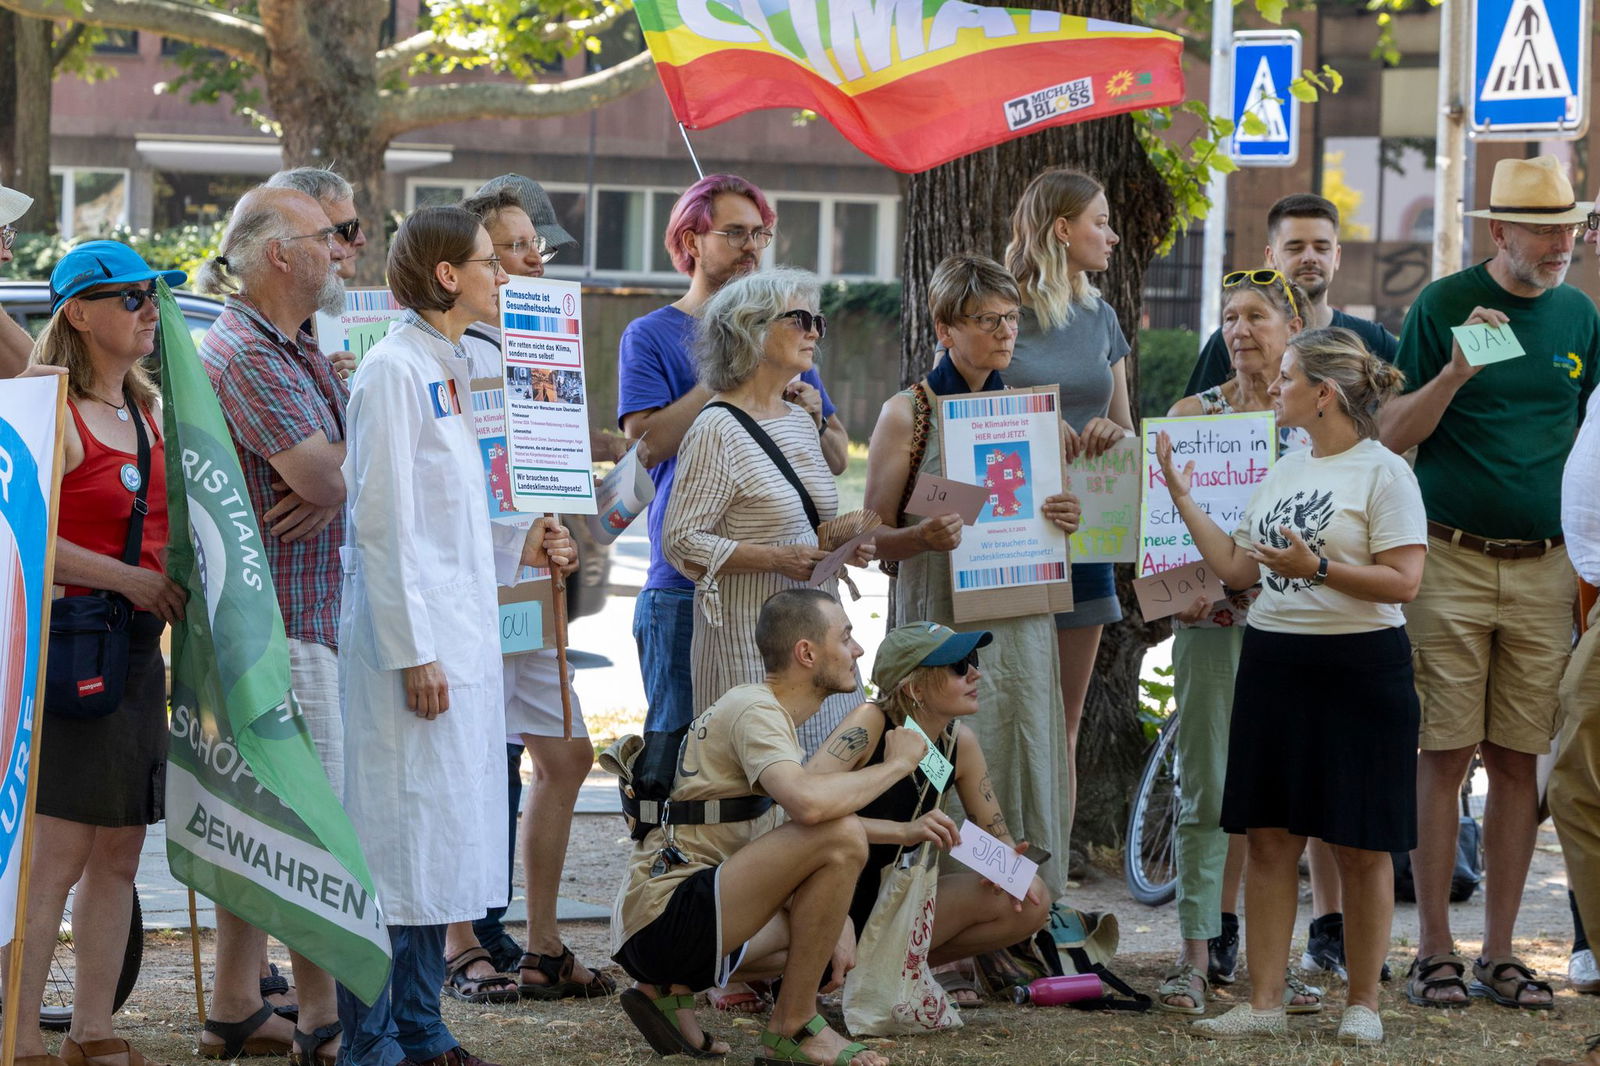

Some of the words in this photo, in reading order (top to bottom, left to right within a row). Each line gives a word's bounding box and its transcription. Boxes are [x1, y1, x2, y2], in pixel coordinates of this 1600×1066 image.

[1031, 79, 1089, 105] MICHAEL
[505, 289, 541, 302] Klimaschutz
[541, 293, 550, 302] ist
[506, 300, 561, 315] Gesundheitsschutz
[341, 316, 351, 324] Die
[352, 315, 383, 324] Klimakrise
[1468, 327, 1511, 352] JA!
[508, 340, 516, 348] Wir
[516, 341, 532, 349] retten
[532, 342, 545, 350] nicht
[555, 345, 572, 354] Klima,
[508, 350, 528, 358] sondern
[538, 352, 555, 360] selbst!
[971, 421, 984, 430] Die
[984, 419, 1020, 429] Klimakrise
[1020, 418, 1029, 427] ist
[975, 432, 992, 441] HIER
[992, 431, 1006, 440] und
[1146, 430, 1241, 454] Ivestition
[1250, 430, 1267, 451] in
[517, 473, 526, 481] Wir
[525, 473, 550, 482] brauchen
[1149, 458, 1268, 489] Kmaschutz
[517, 482, 583, 494] Landesklimaschutzgesetz!
[927, 484, 948, 501] Ja
[980, 541, 993, 550] Wir
[994, 539, 1027, 549] brauchen
[1027, 538, 1039, 546] das
[1144, 534, 1177, 548] neue
[969, 549, 1053, 563] Landesklimaschutzgesetz!
[1141, 552, 1195, 576] Arbeit
[503, 611, 529, 640] OUI
[0, 695, 34, 835] URE
[972, 834, 1023, 884] JA!
